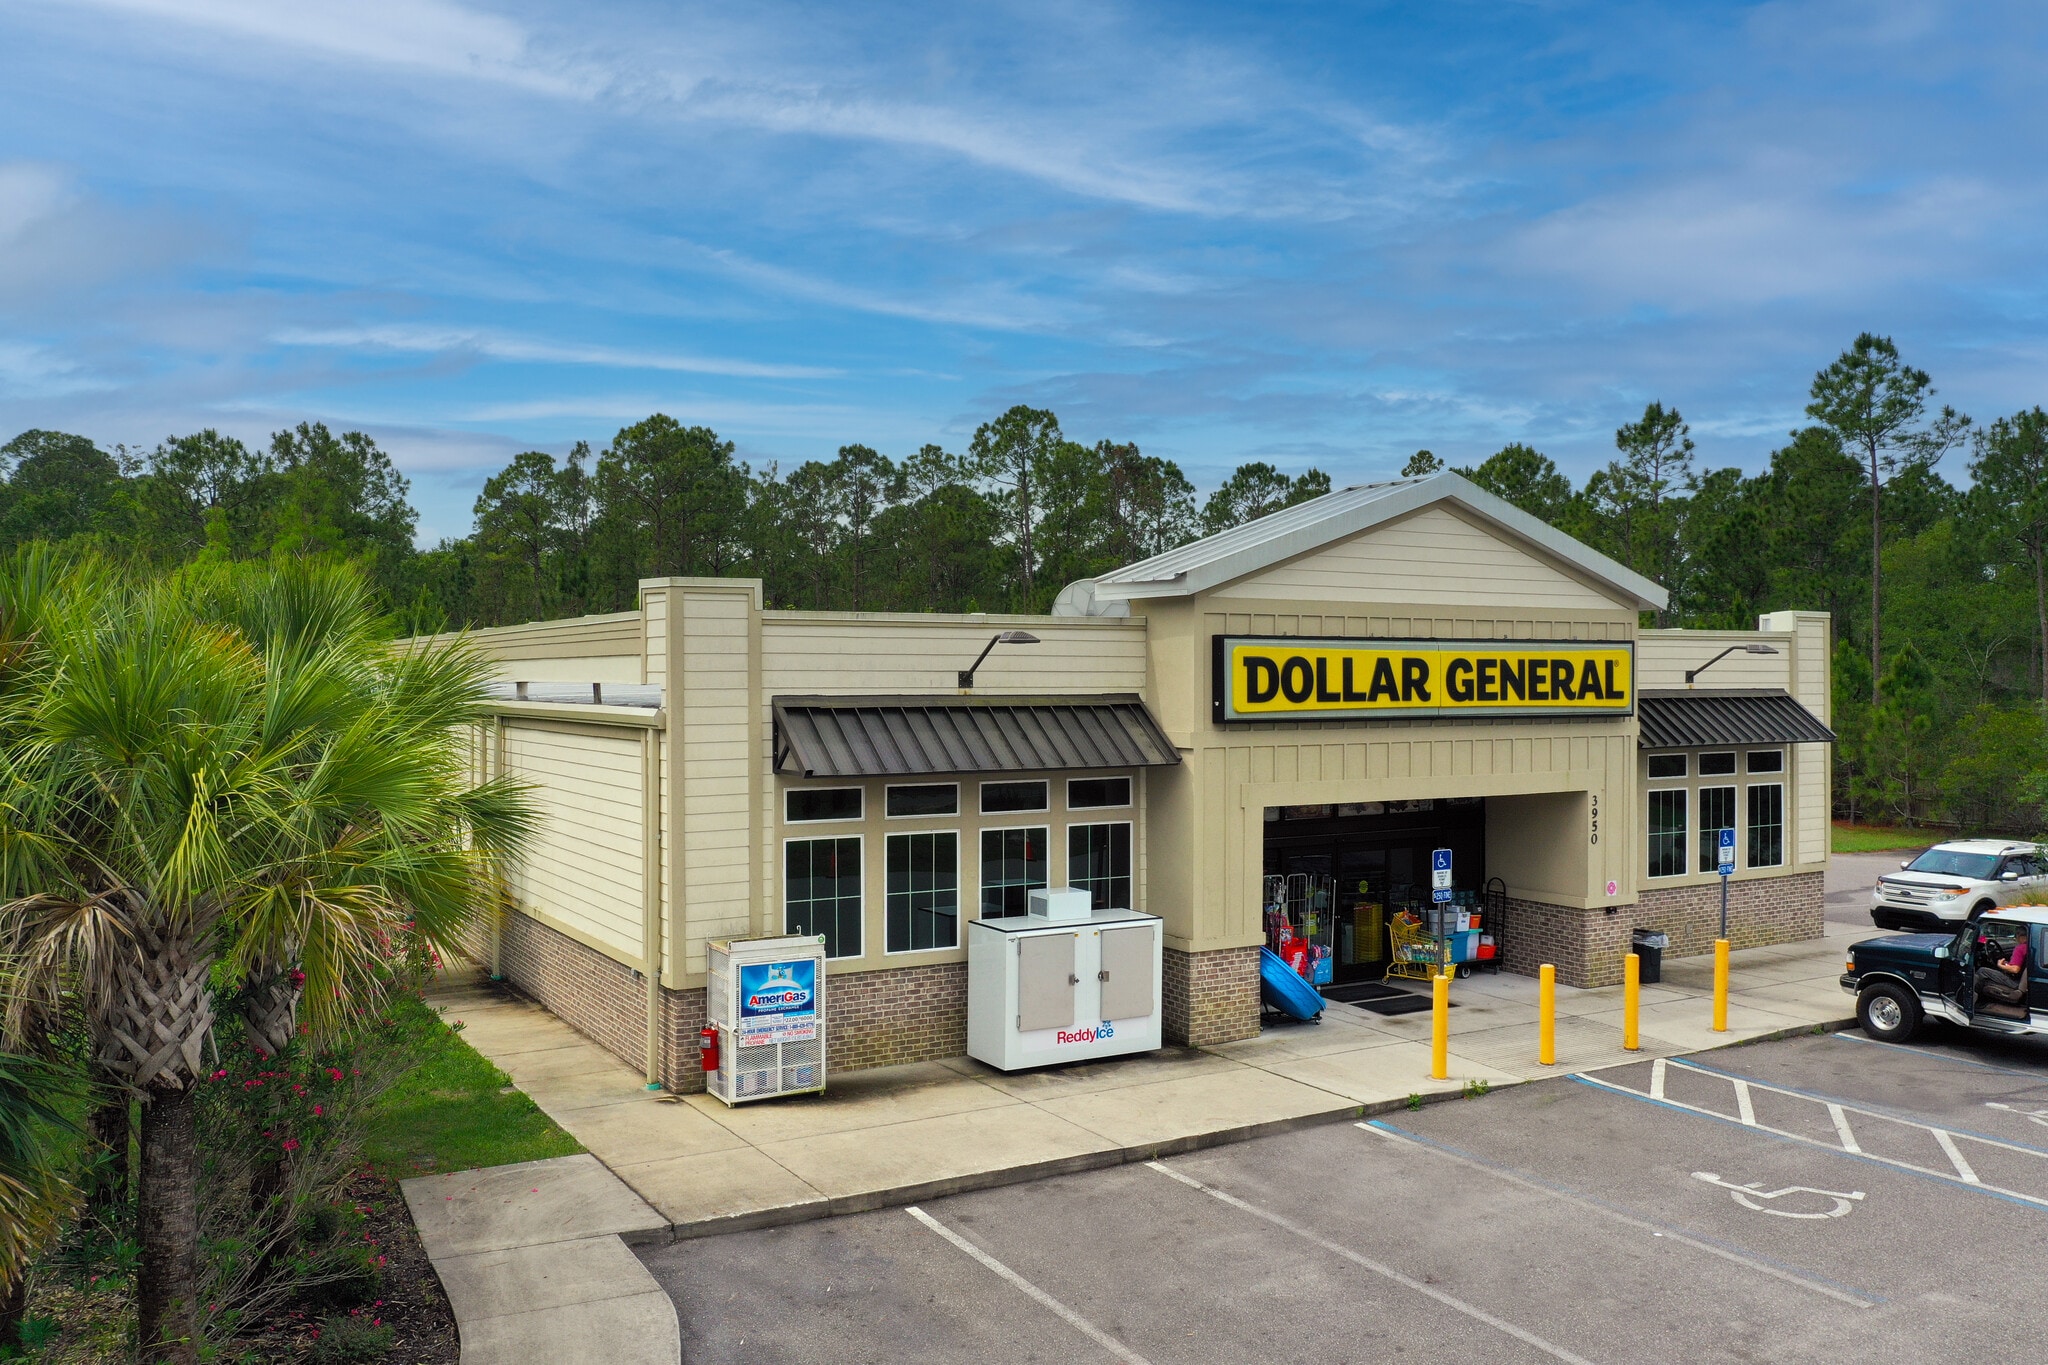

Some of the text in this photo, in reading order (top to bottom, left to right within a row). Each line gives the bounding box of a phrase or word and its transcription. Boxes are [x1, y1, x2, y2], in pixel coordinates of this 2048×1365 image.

[1242, 655, 1625, 704] DOLLAR GENERAL
[749, 992, 806, 1006] AmeriGas
